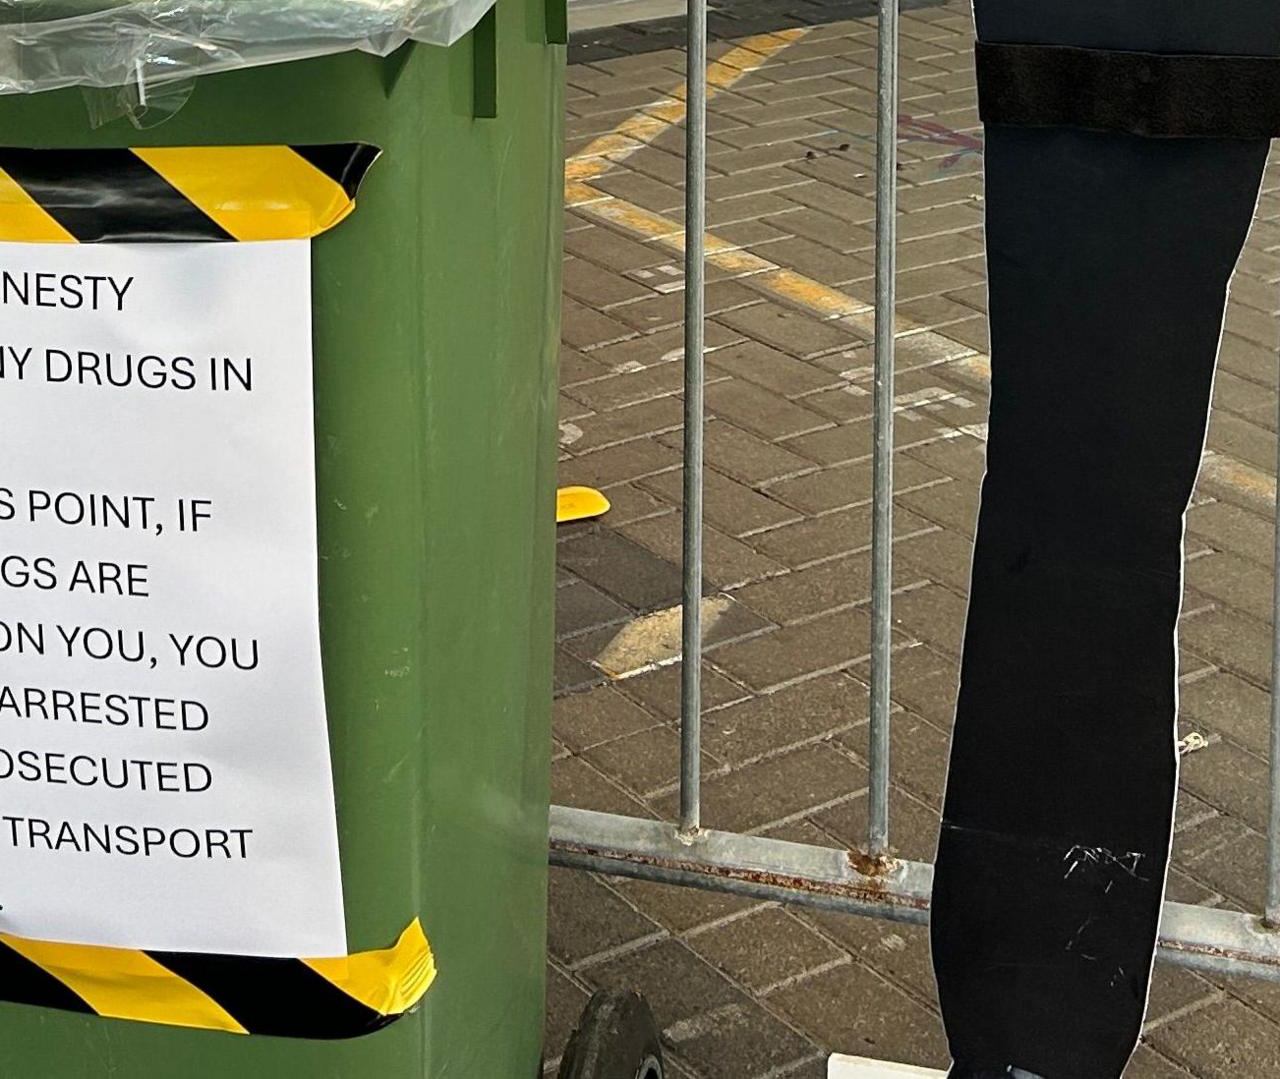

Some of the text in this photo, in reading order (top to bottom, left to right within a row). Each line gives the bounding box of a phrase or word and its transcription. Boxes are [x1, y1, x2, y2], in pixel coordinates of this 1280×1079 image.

[45, 348, 196, 391] DRUGS
[210, 357, 252, 392] IN
[28, 489, 163, 537] POINT,
[178, 498, 212, 532] IF
[68, 560, 149, 598] ARE
[56, 624, 157, 669] YOU,
[168, 633, 259, 671] YOU
[2, 815, 254, 859] TRANSPORT
